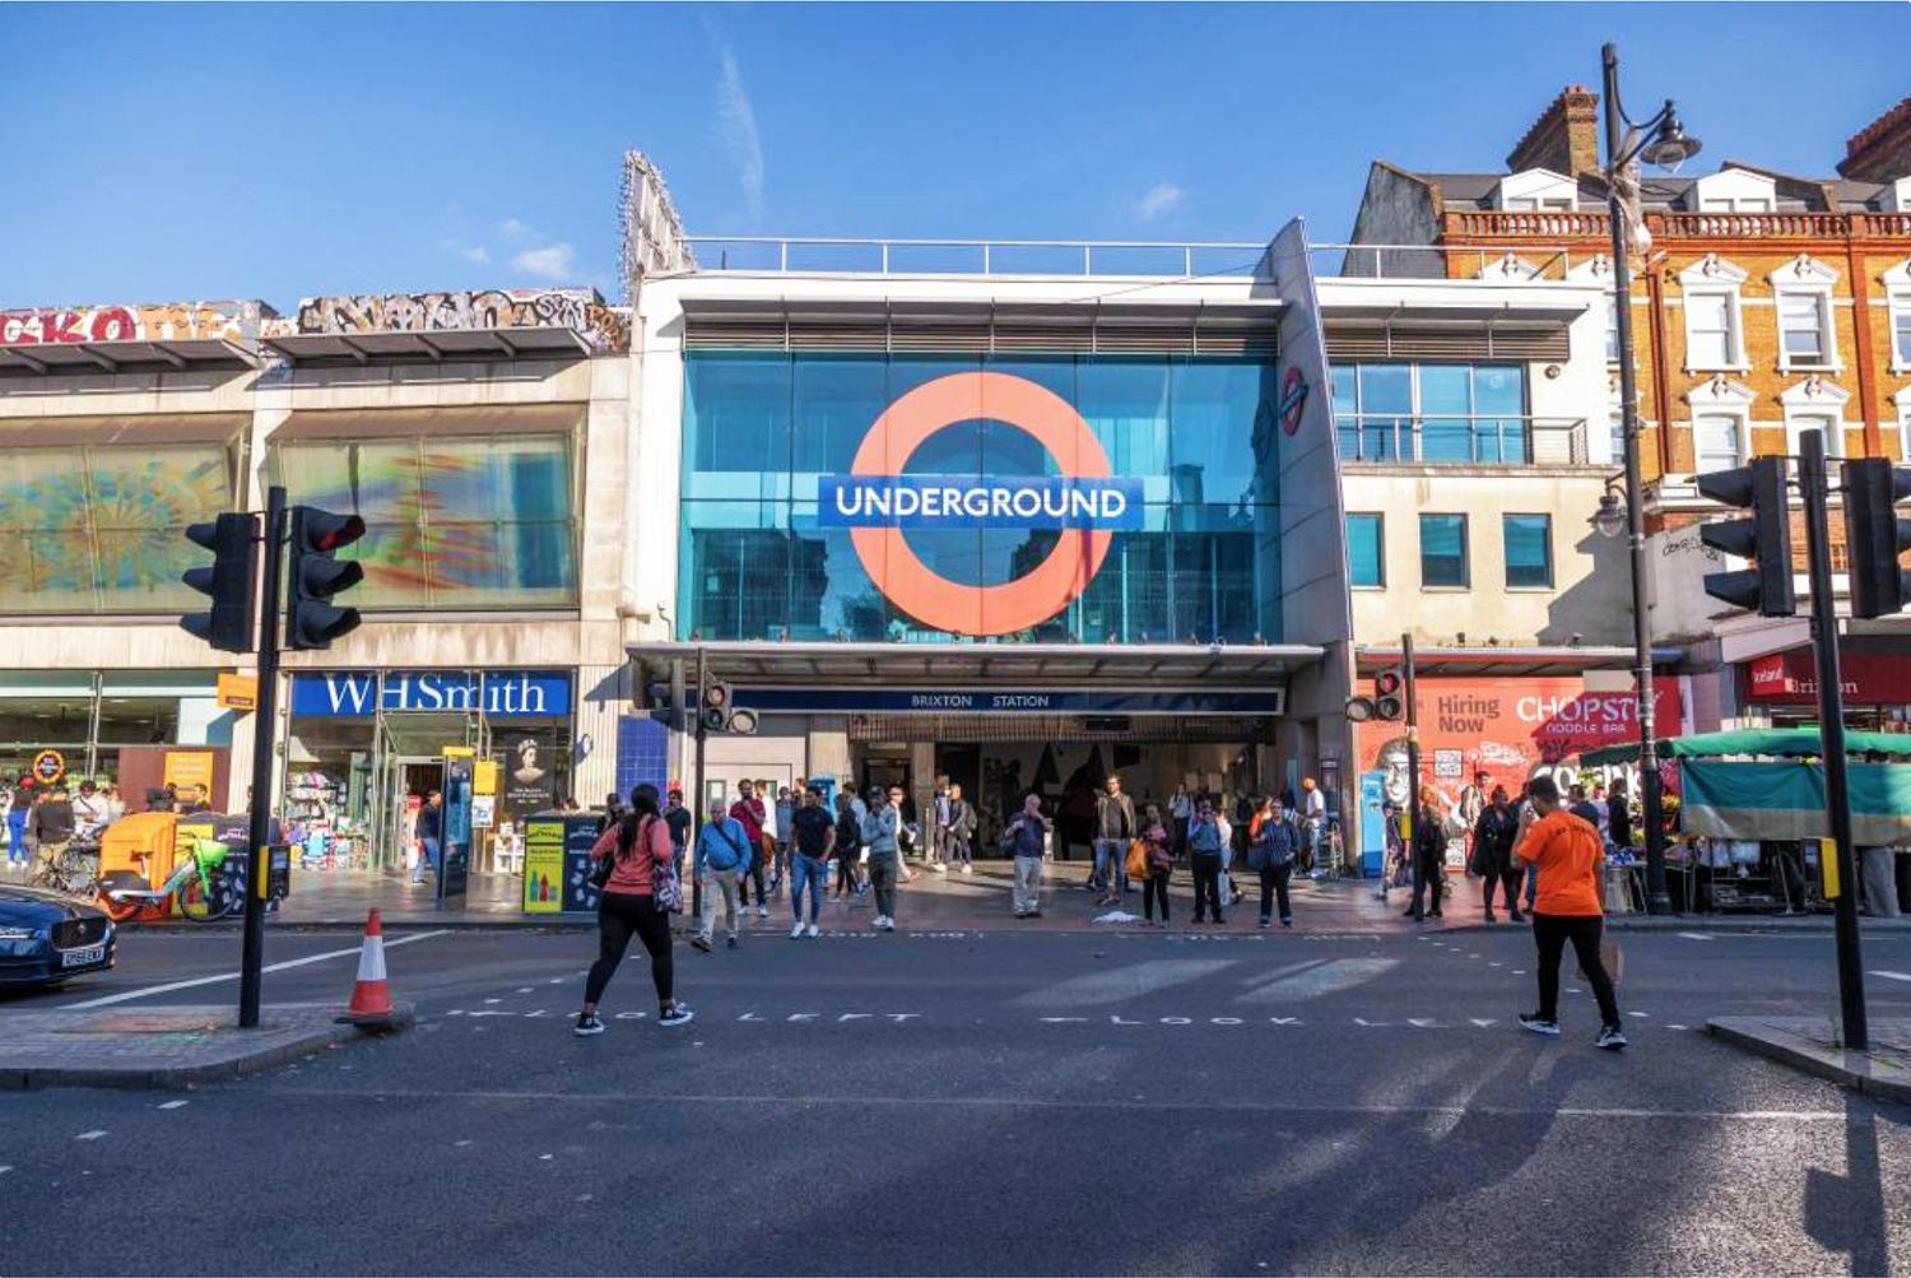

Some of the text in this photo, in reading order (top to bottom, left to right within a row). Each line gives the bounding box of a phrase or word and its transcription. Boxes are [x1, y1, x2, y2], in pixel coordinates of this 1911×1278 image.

[836, 486, 1127, 518] UNDERGROUND
[323, 672, 548, 714] WHSmith
[911, 694, 1050, 707] BRIXTON STATION
[1438, 694, 1501, 719] Hiring
[1438, 716, 1484, 732] Now
[735, 1011, 922, 1021] LEFT
[1110, 1015, 1304, 1025] LOOK
